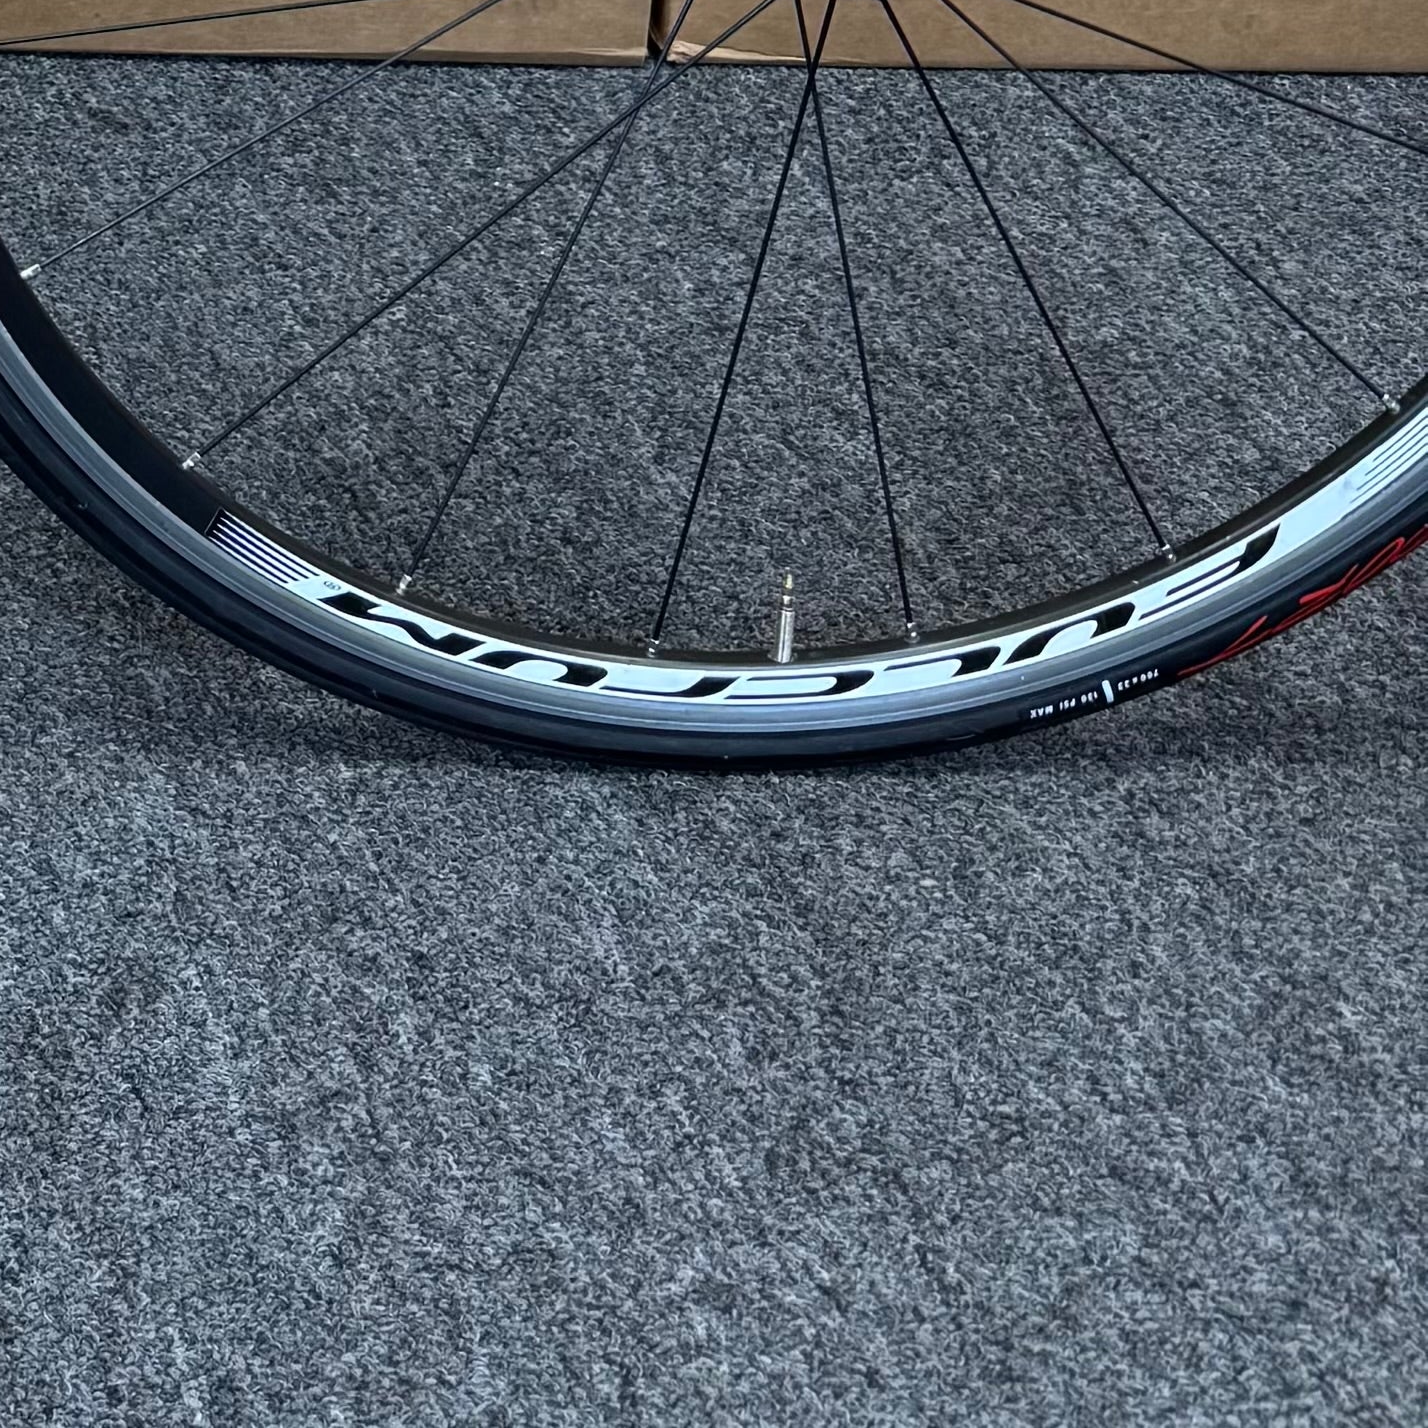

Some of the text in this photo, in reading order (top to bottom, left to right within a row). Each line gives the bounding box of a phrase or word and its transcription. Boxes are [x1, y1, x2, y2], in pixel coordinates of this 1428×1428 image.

[317, 523, 1282, 701] FULCRUM
[1030, 704, 1054, 720] MAX
[1059, 698, 1076, 712] PSI
